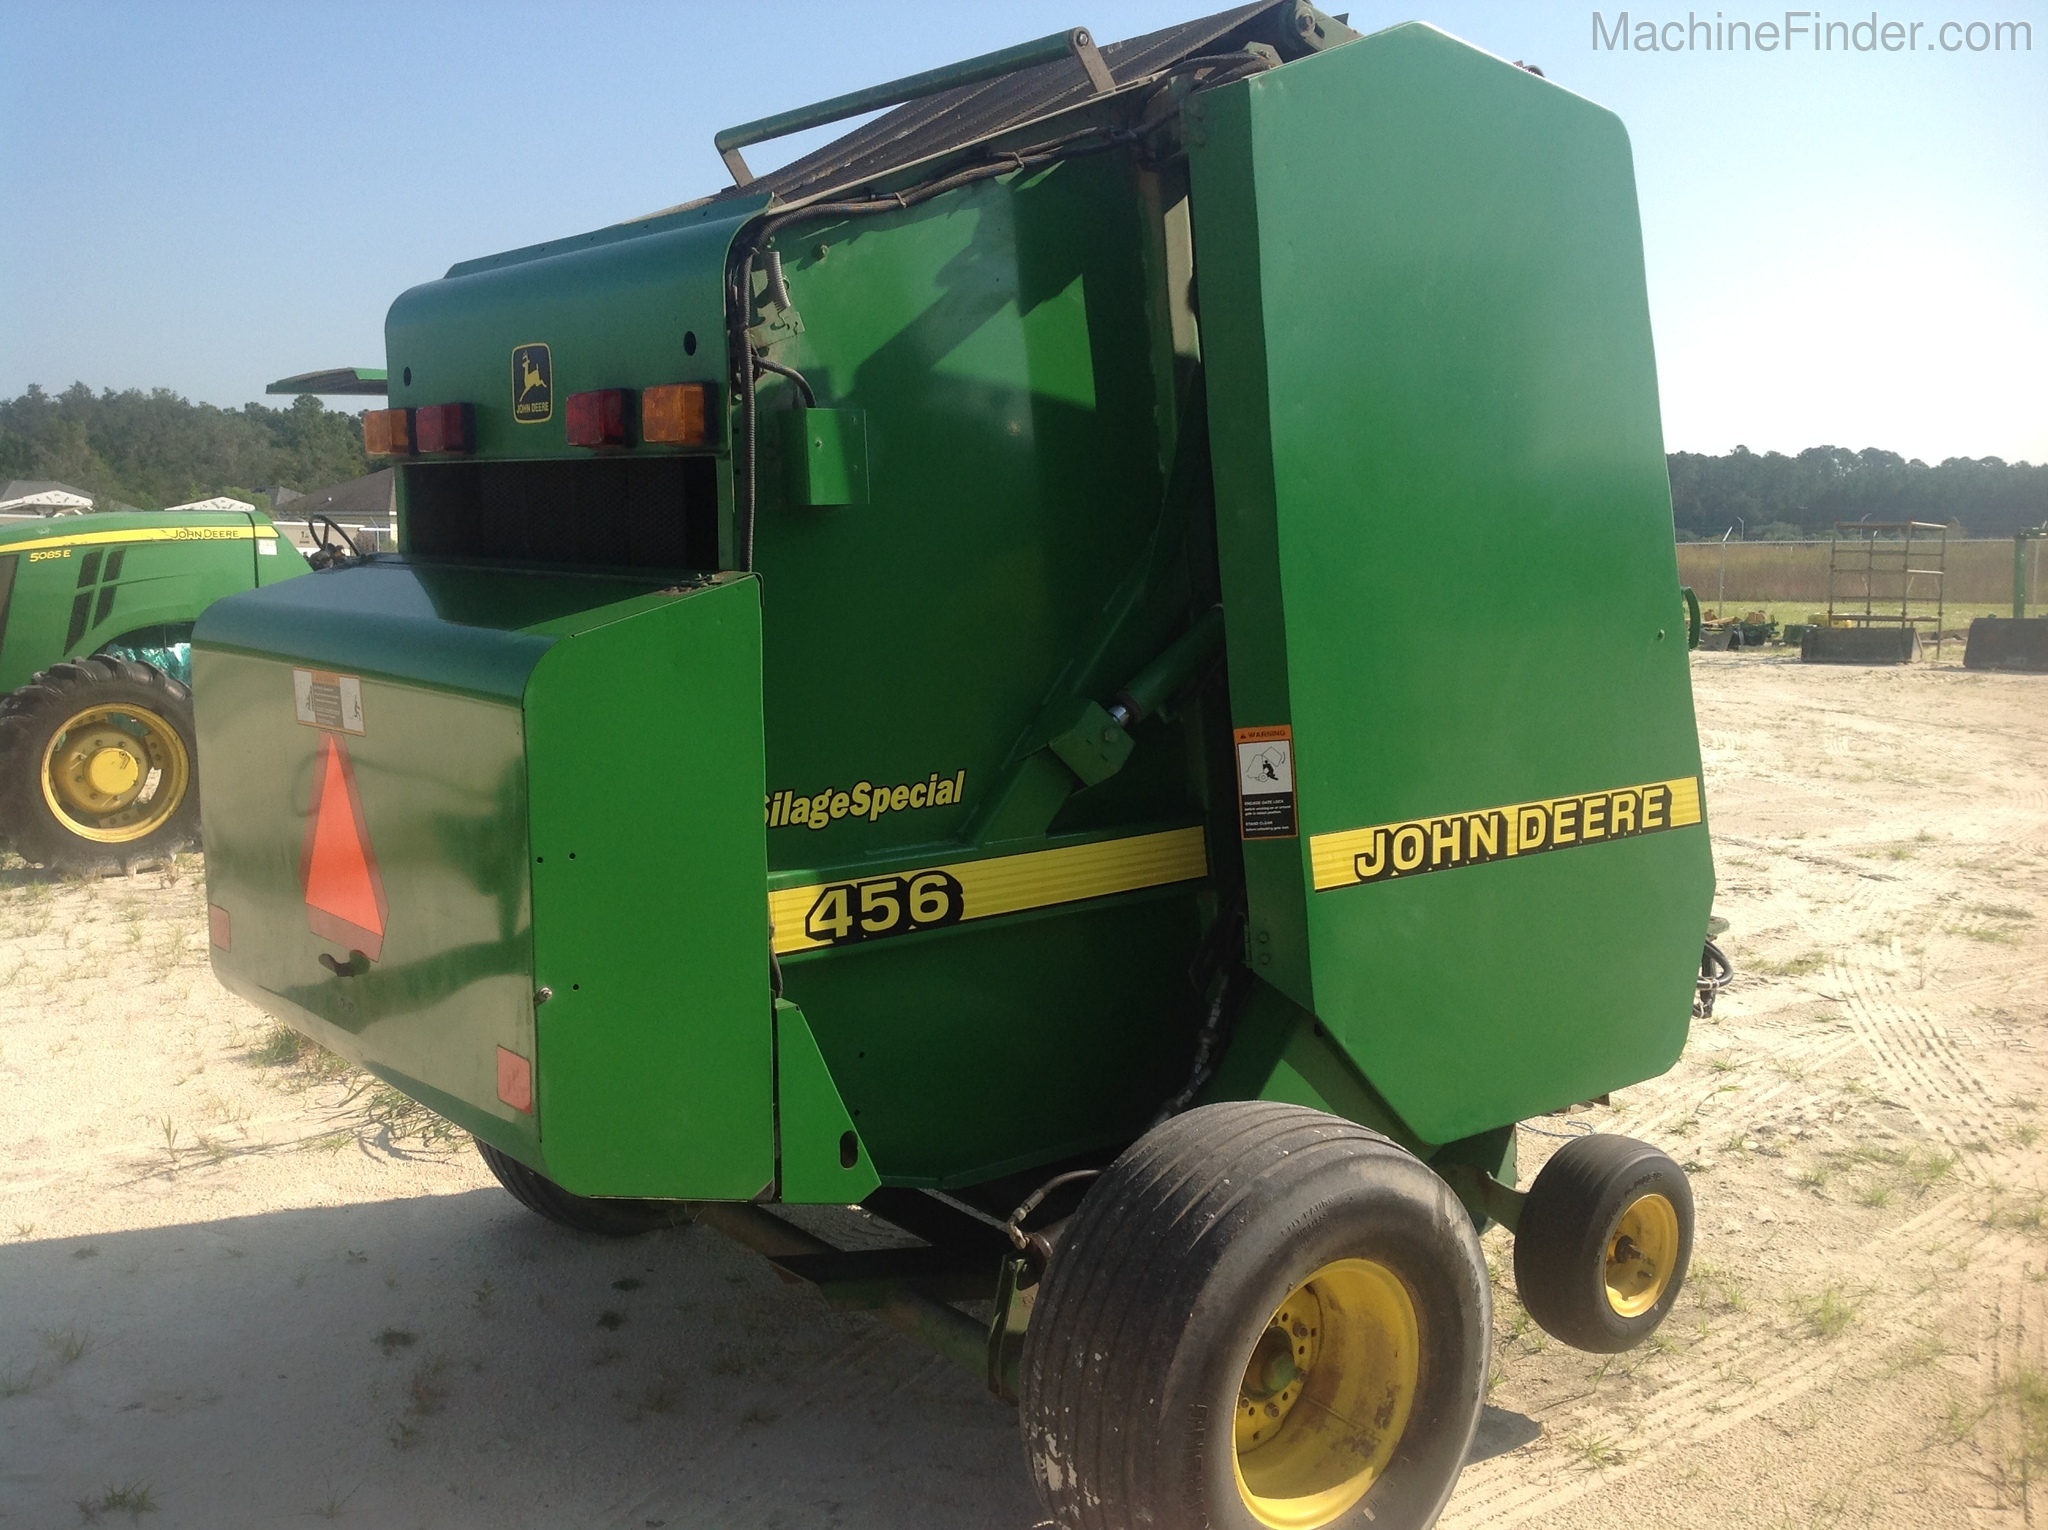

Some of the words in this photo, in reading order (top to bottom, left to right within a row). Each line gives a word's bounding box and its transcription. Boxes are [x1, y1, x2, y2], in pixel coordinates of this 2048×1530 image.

[517, 403, 531, 414] JOHN
[531, 401, 550, 412] DEERE
[173, 529, 202, 539] JOHN
[204, 529, 239, 538] DEERE
[29, 550, 62, 563] 5085
[1248, 729, 1286, 739] WARNING
[764, 769, 966, 830] ilageSpecial
[1355, 811, 1506, 880] JOHN
[1518, 785, 1670, 851] DEERE
[806, 871, 960, 943] 456
